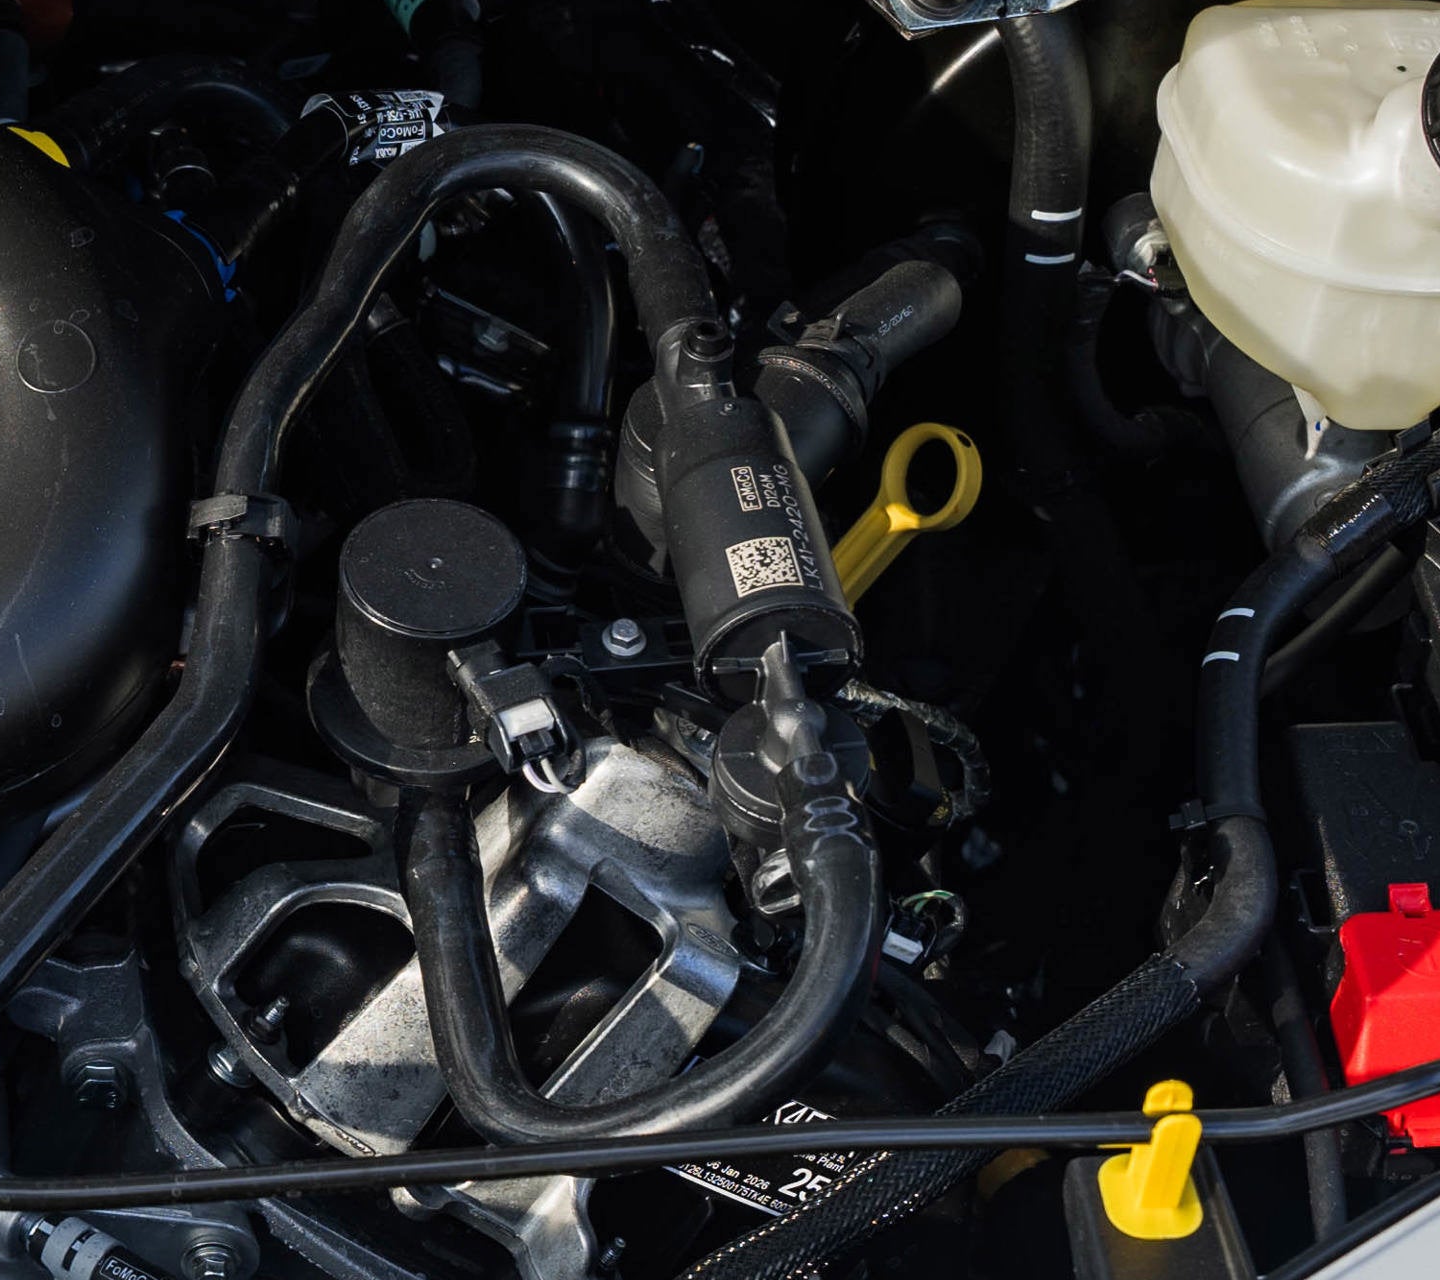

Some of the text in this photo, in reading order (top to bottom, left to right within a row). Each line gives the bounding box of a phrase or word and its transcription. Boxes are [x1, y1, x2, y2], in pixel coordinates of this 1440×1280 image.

[380, 124, 424, 139] FoMoCo
[736, 467, 759, 510] FoMoCo
[759, 474, 781, 508] D126M
[721, 1164, 740, 1179] Jan
[743, 1173, 770, 1191] 2026
[818, 1156, 845, 1173] Plant
